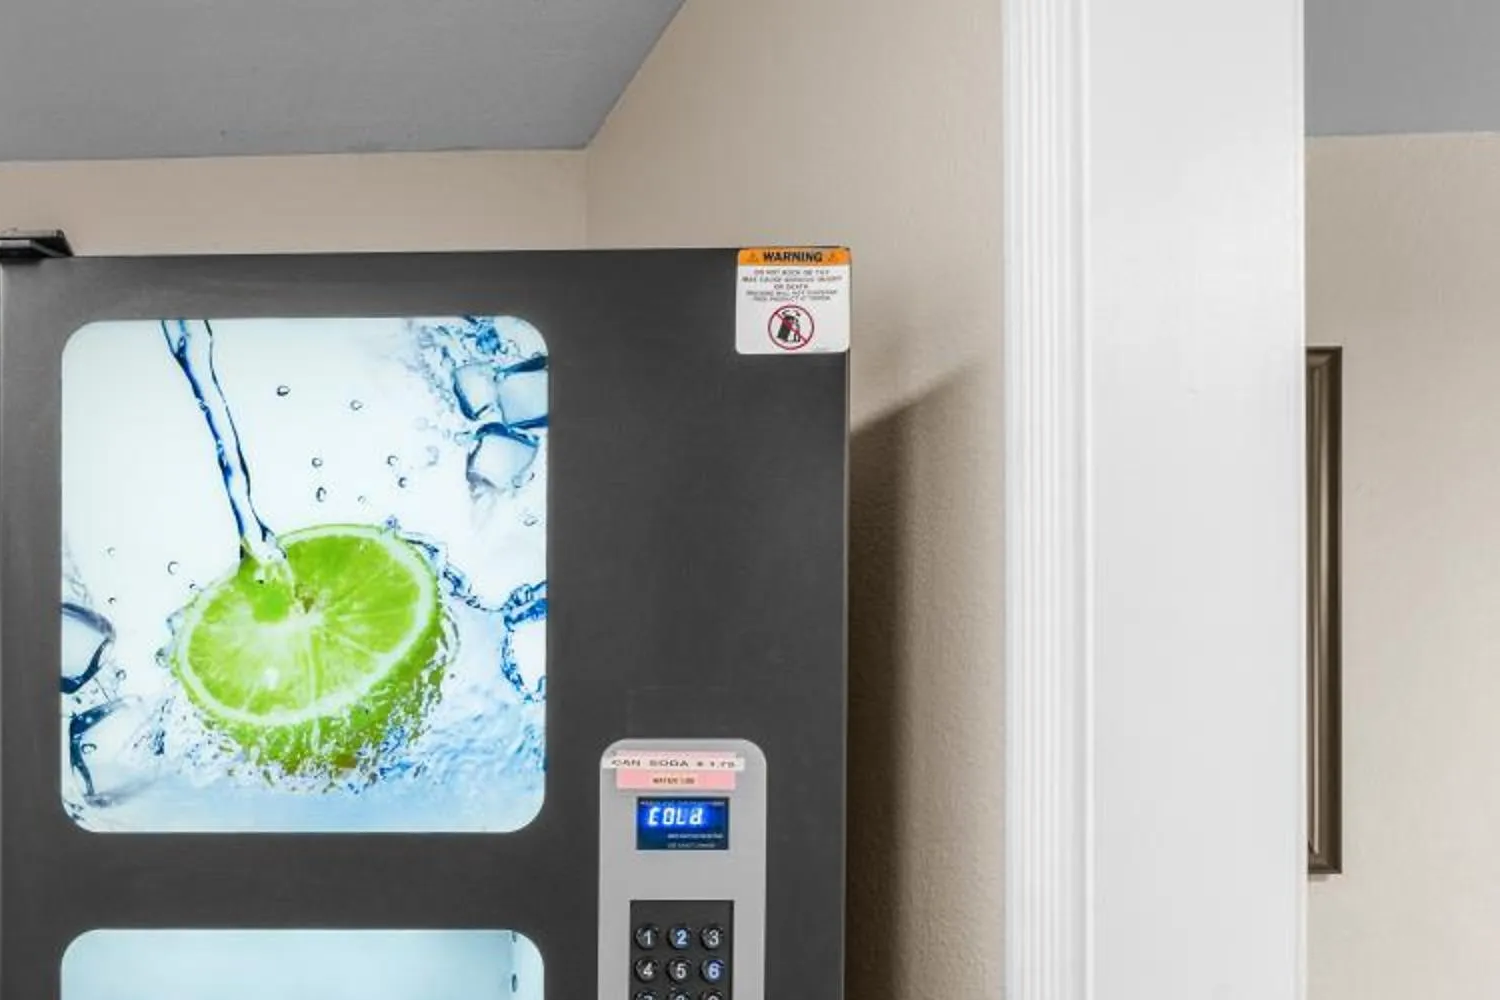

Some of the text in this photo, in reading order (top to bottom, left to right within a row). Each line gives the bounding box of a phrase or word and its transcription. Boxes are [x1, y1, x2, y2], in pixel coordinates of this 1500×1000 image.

[763, 251, 823, 262] WARNING
[611, 759, 641, 767] CAN
[649, 759, 689, 767] SODA
[643, 931, 652, 945] 1
[676, 930, 687, 945] 2
[708, 930, 719, 946] 3
[642, 963, 653, 977] 4
[676, 963, 687, 979] 5
[708, 963, 720, 978] 6
